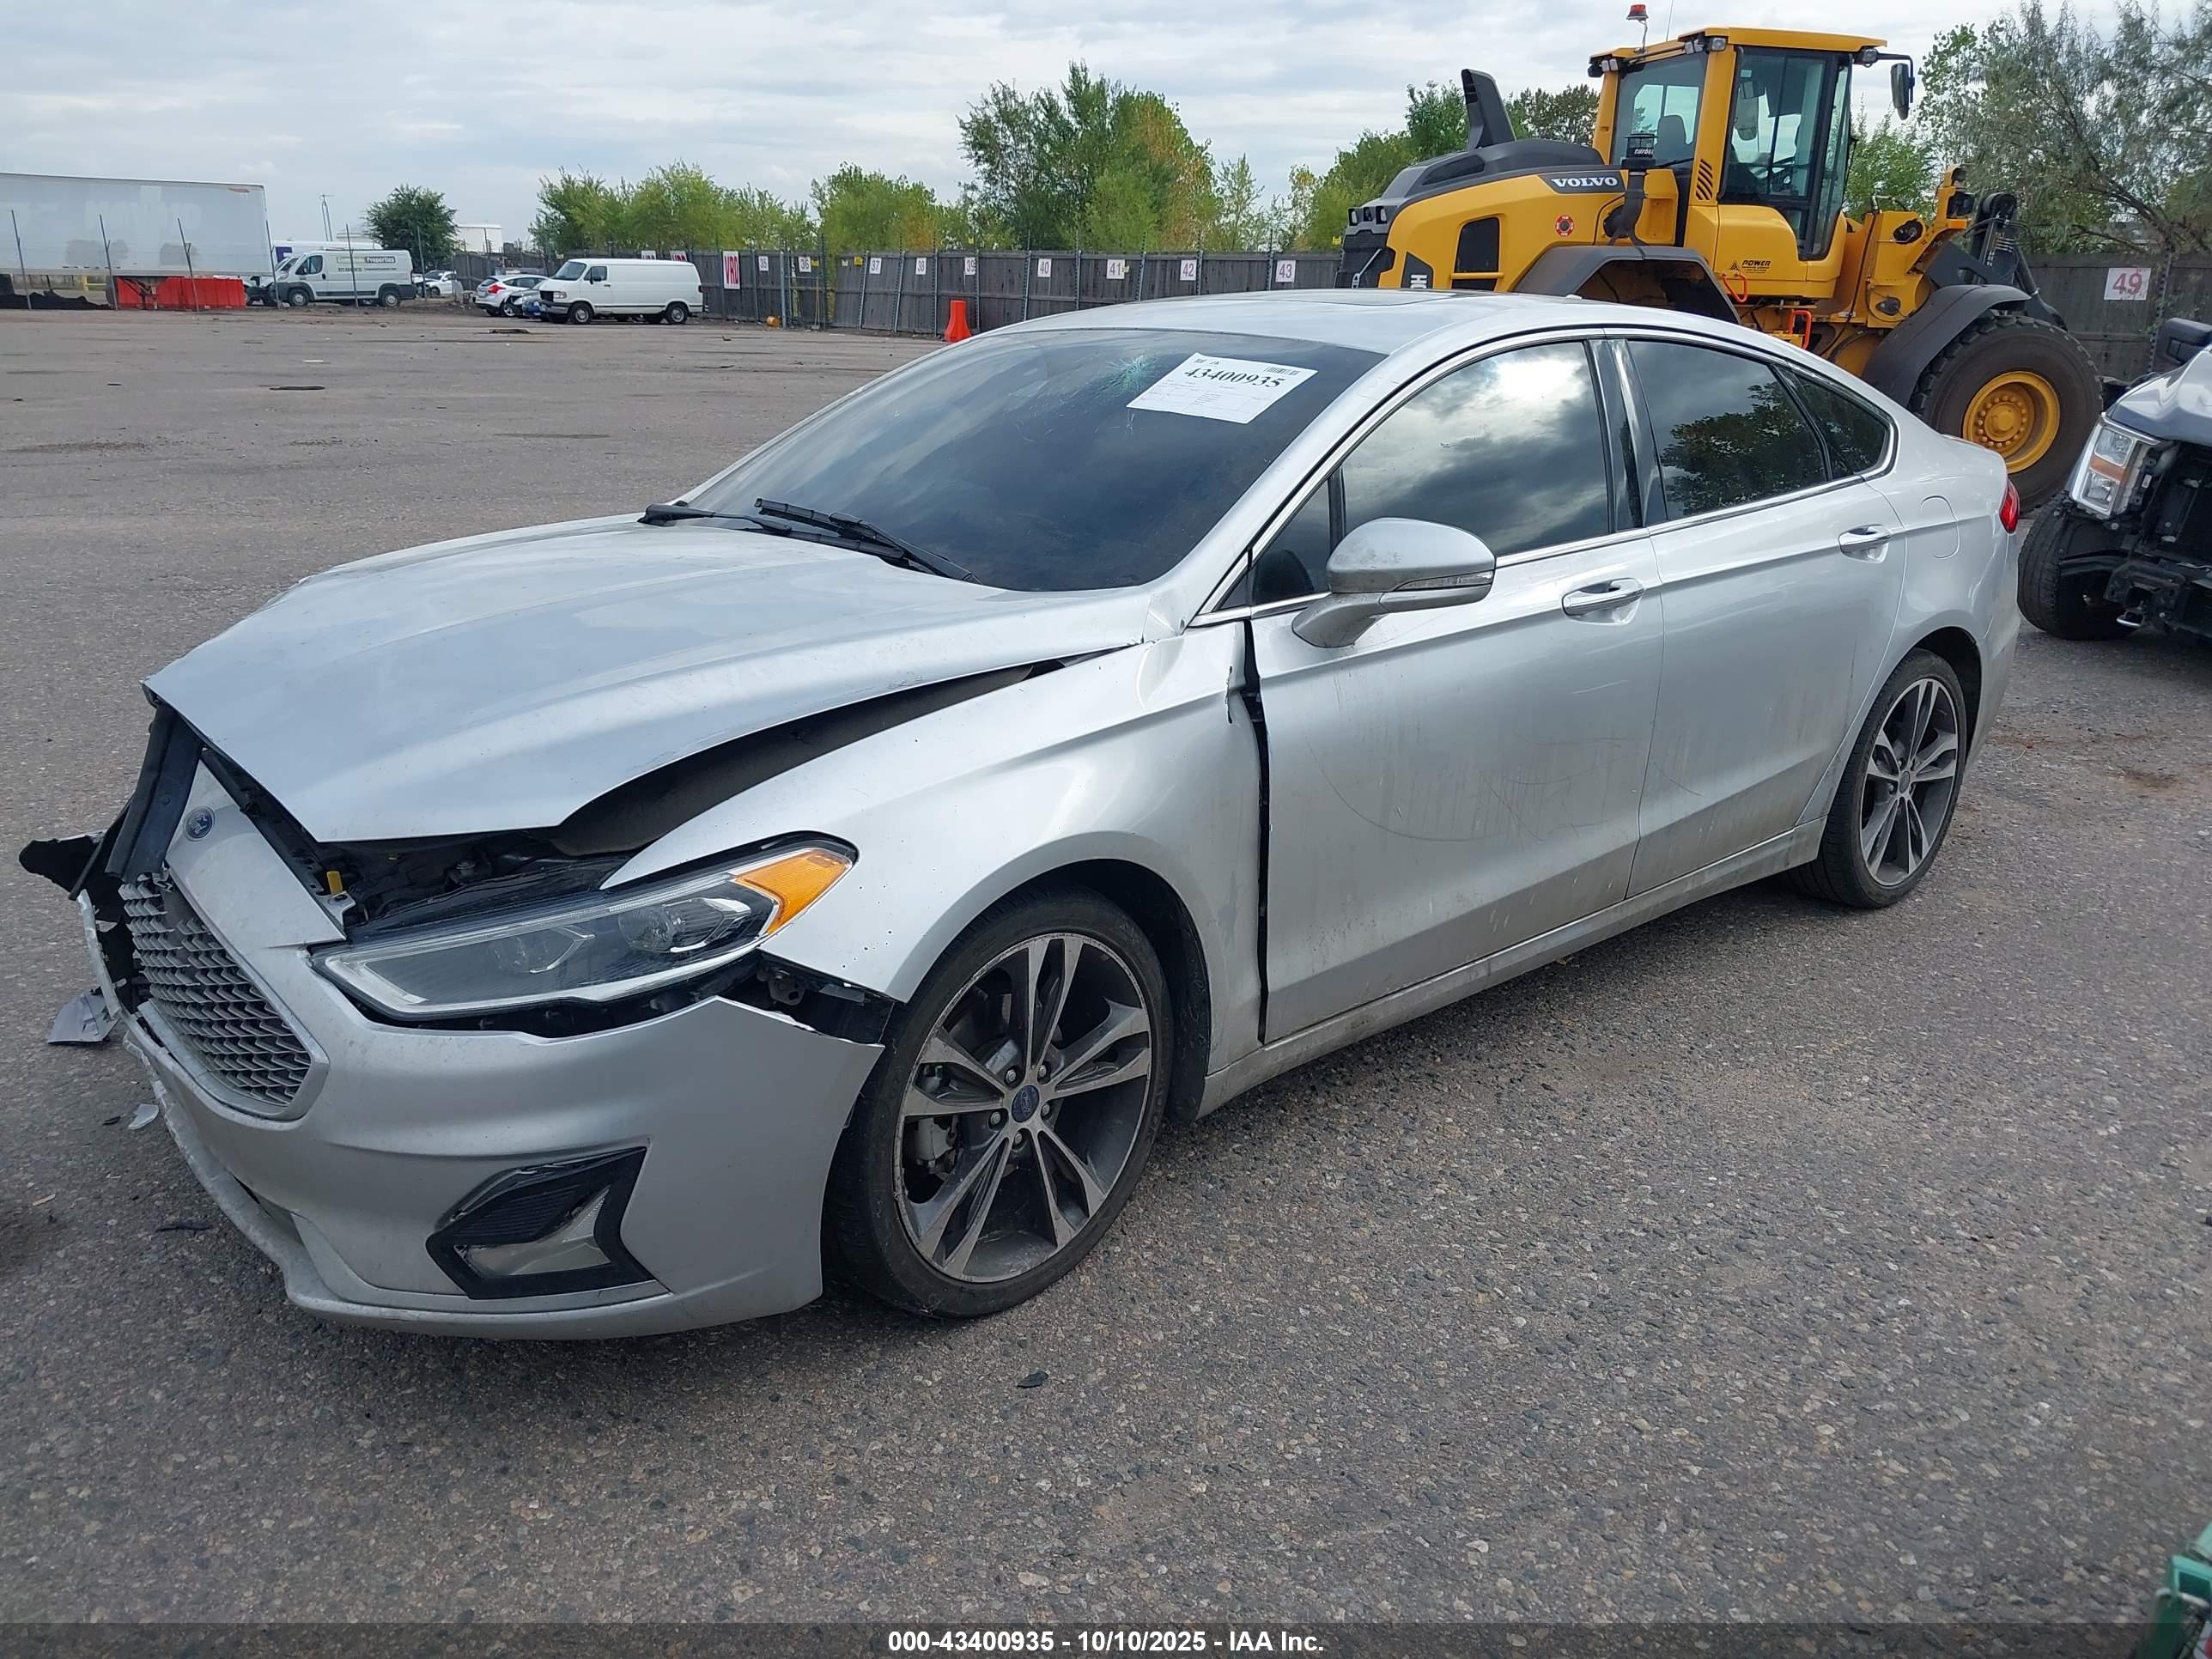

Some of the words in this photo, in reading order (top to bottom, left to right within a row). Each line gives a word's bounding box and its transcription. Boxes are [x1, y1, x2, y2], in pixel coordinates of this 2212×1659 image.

[1551, 177, 1618, 187] VOLVO
[760, 258, 768, 269] 35
[800, 259, 810, 270] 36
[871, 259, 880, 272] 37
[917, 259, 925, 272] 38
[1039, 261, 1049, 274] 40
[1109, 262, 1121, 276] 41
[1182, 262, 1194, 277] 42
[1279, 263, 1292, 278] 43
[2112, 272, 2142, 295] 49
[1184, 367, 1286, 388] 43400935
